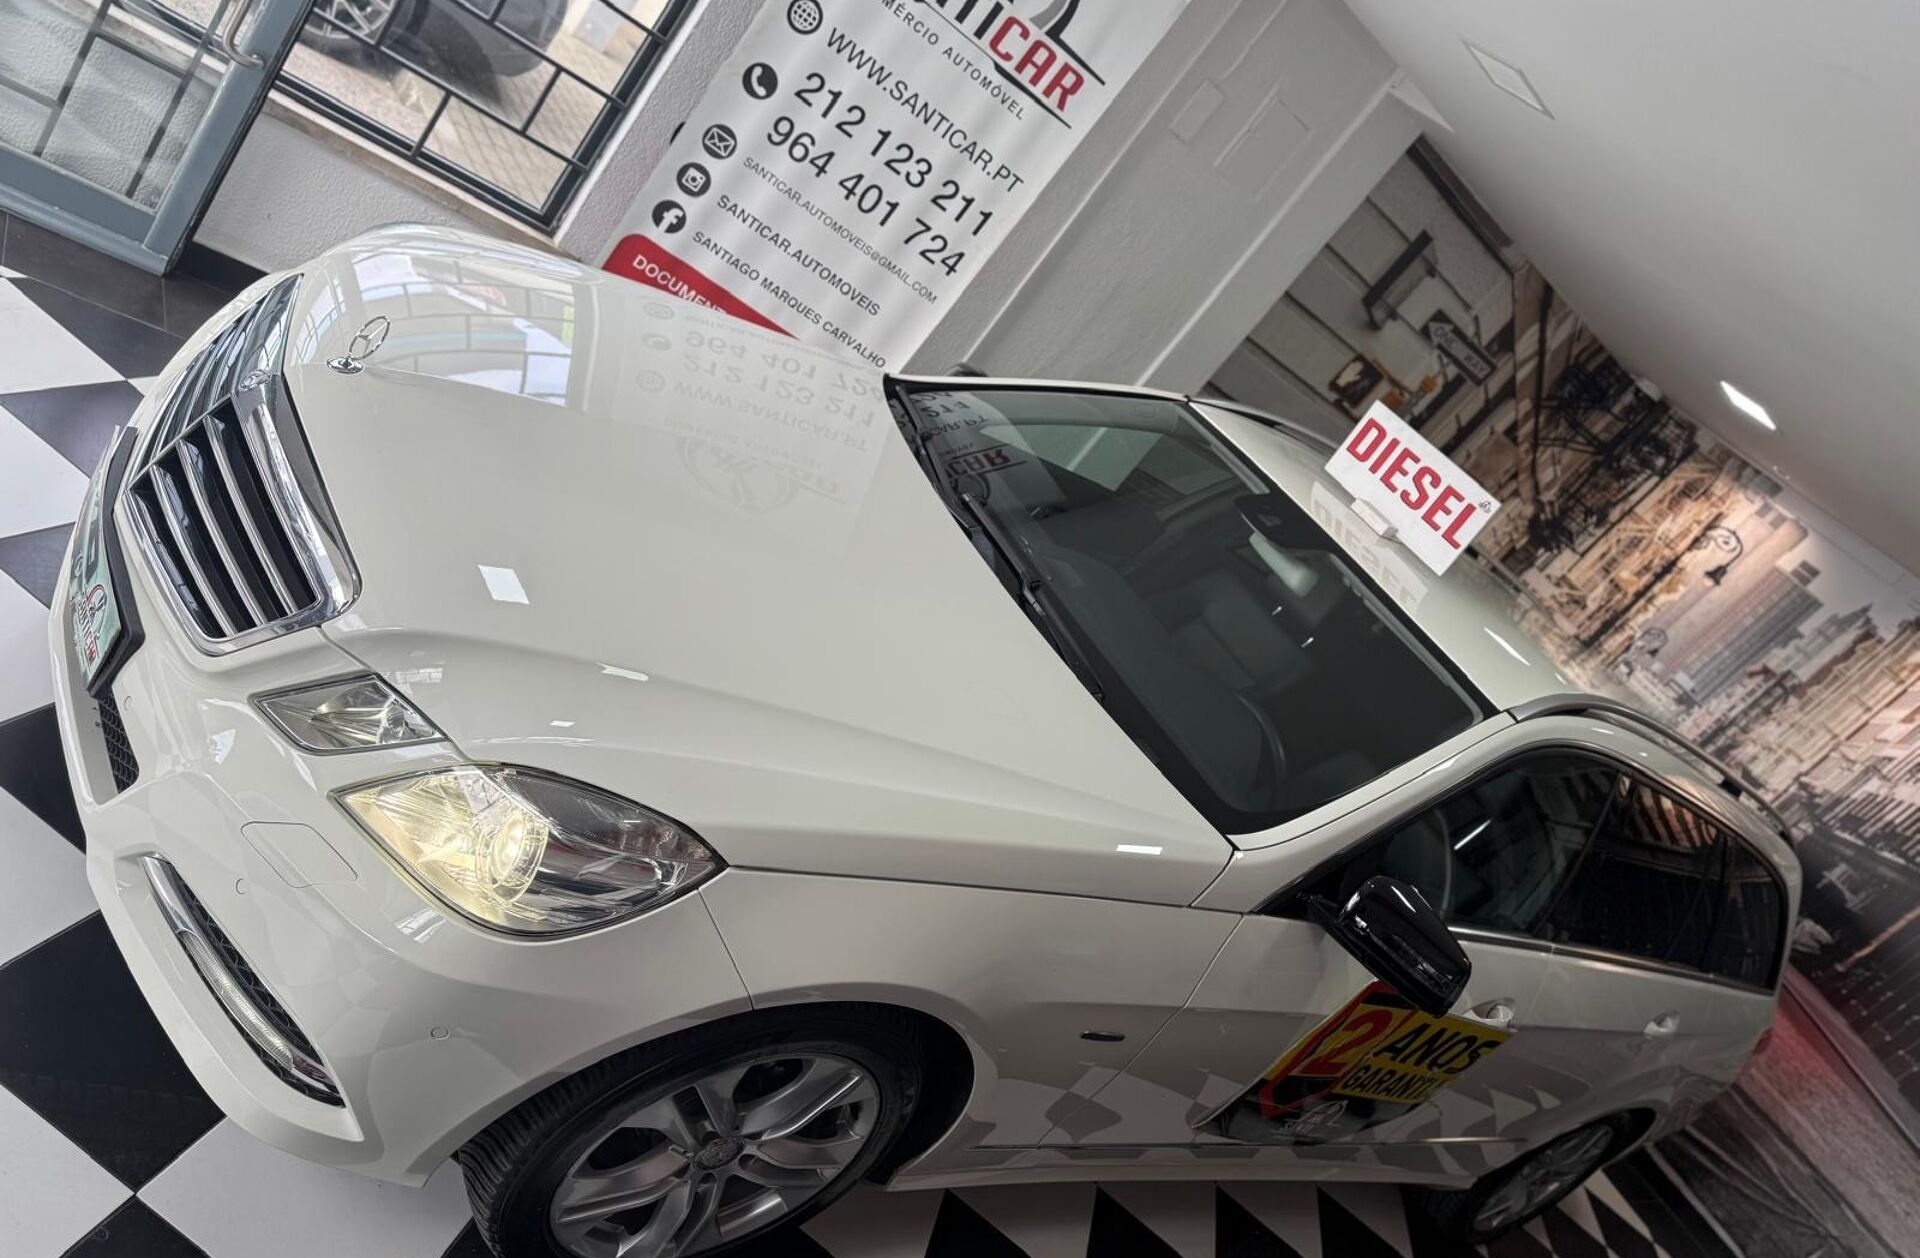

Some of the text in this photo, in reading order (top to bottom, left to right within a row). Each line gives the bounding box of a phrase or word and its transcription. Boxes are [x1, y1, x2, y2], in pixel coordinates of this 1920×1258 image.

[827, 27, 1025, 193] WWW.SANTICAR.PT
[942, 47, 1024, 120] AUTOMÓVEL
[767, 116, 965, 276] 964 401 724
[794, 72, 993, 236] 212 123 211
[717, 194, 880, 316] SANTICAR.AUTOMOVEIS
[743, 156, 937, 304] SANTICAR.AUTOMOVEIS@GMAIL.COM
[692, 231, 760, 281] SANTIAGO
[761, 274, 822, 325] MARQUES
[822, 321, 886, 368] CARVALHO
[1346, 417, 1477, 550] DIESEL
[1373, 1023, 1502, 1074] ANOS
